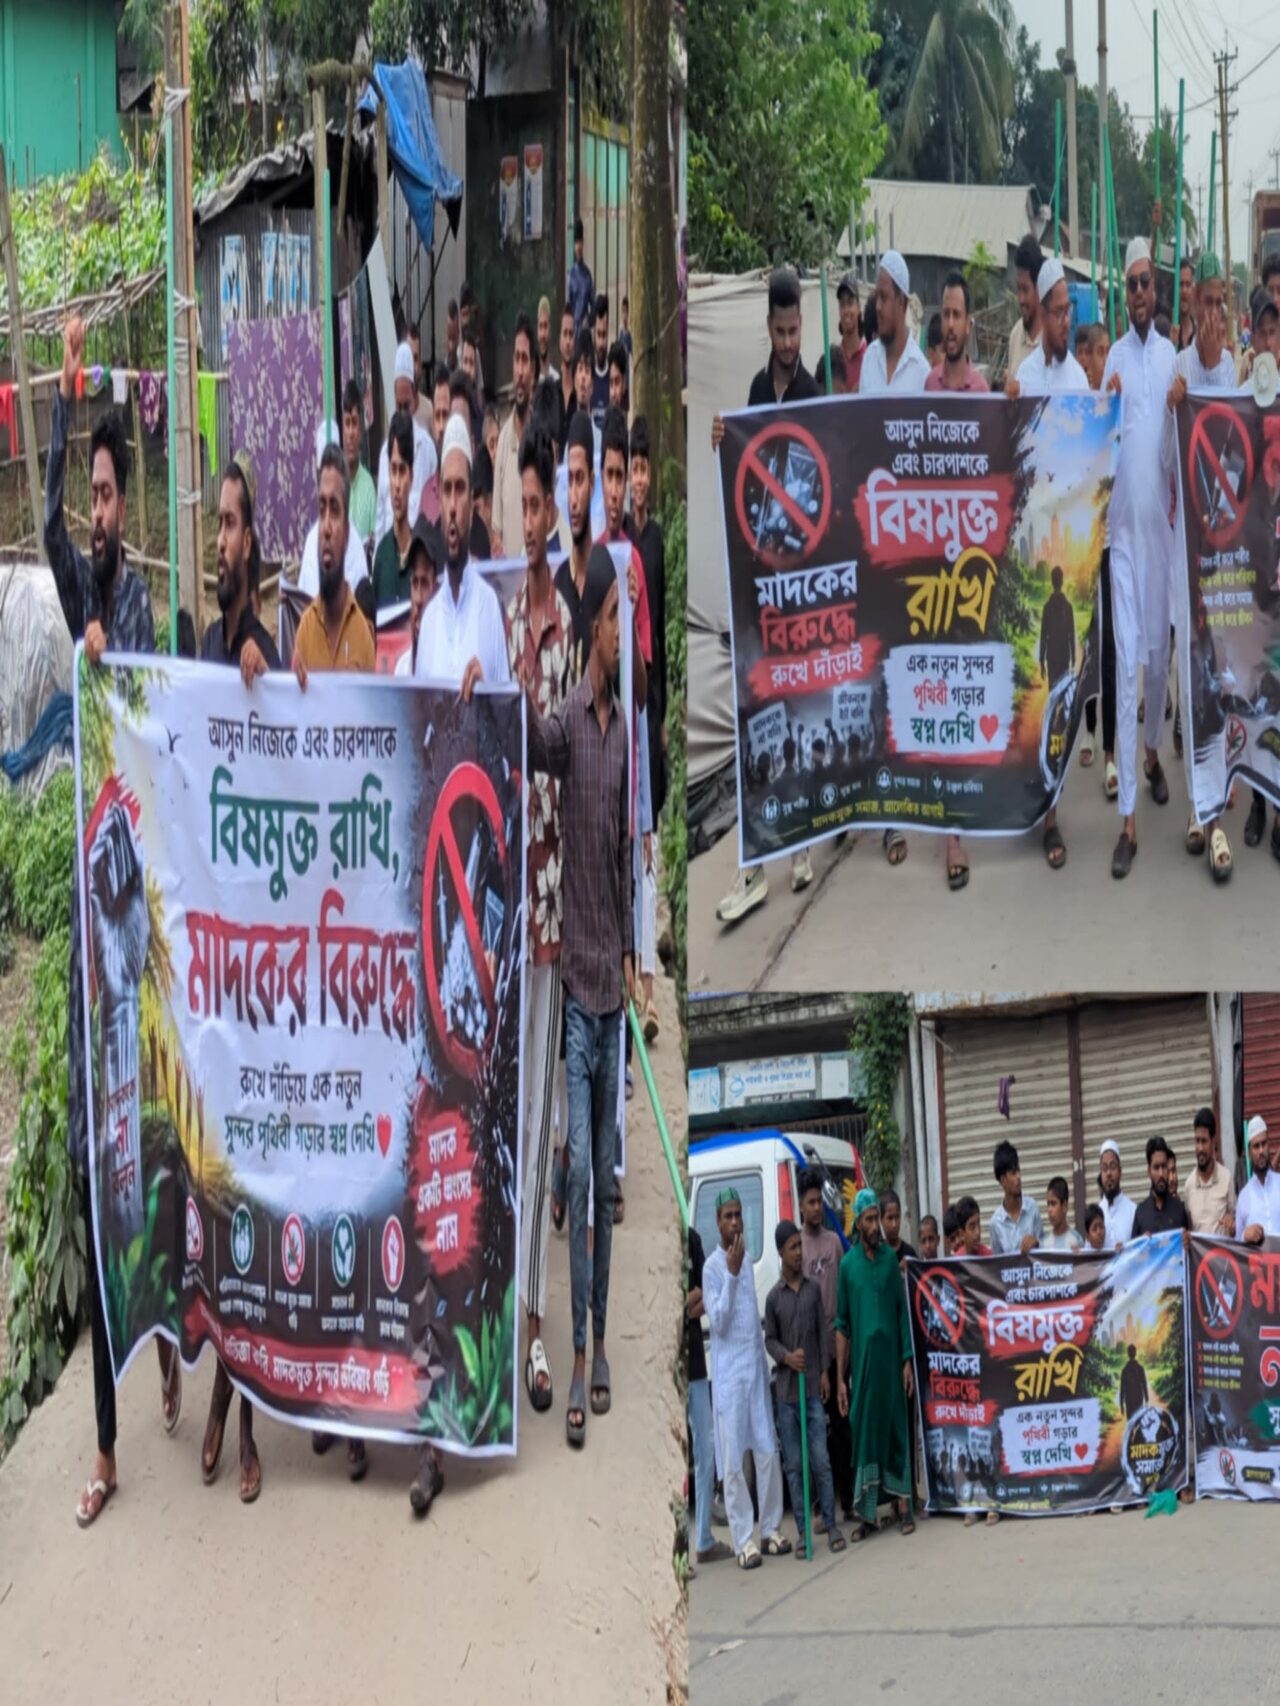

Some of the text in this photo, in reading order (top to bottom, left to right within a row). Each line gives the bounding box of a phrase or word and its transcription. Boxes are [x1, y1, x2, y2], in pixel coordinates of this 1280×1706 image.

[884, 412, 980, 450] আসুন নিজেকে
[892, 452, 989, 476] এবং চারপাশকে
[865, 467, 999, 562] বিষমুক্ত
[755, 561, 857, 610] মাদকের
[906, 547, 998, 636] রাখি
[759, 602, 857, 654] বিরুদ্ধে
[770, 644, 864, 689] রুখে দাঁড়াই
[907, 654, 994, 682] এক নতুন সুন্দর
[913, 680, 985, 713] পৃথিবী গড়ার
[208, 710, 397, 762] আসুন নিজেকে এবং চারপাশকে
[910, 712, 975, 746] স্বপ্ন দেখি
[209, 764, 400, 901] বিষমুক্ত রাখি,
[186, 888, 418, 1043] মাদকের বিরুদ্ধে
[240, 1065, 265, 1101] রুখে
[310, 1073, 332, 1102] এক
[336, 1070, 362, 1108] নতুন
[225, 1112, 375, 1160] সুন্দর পৃথিবী গড়ার স্বপ্ন দেখি
[986, 1299, 1085, 1354] বিষমুক্ত
[927, 1352, 980, 1376] মাদকের
[1014, 1342, 1084, 1402] রাখি
[1044, 1443, 1072, 1463] দেখি
